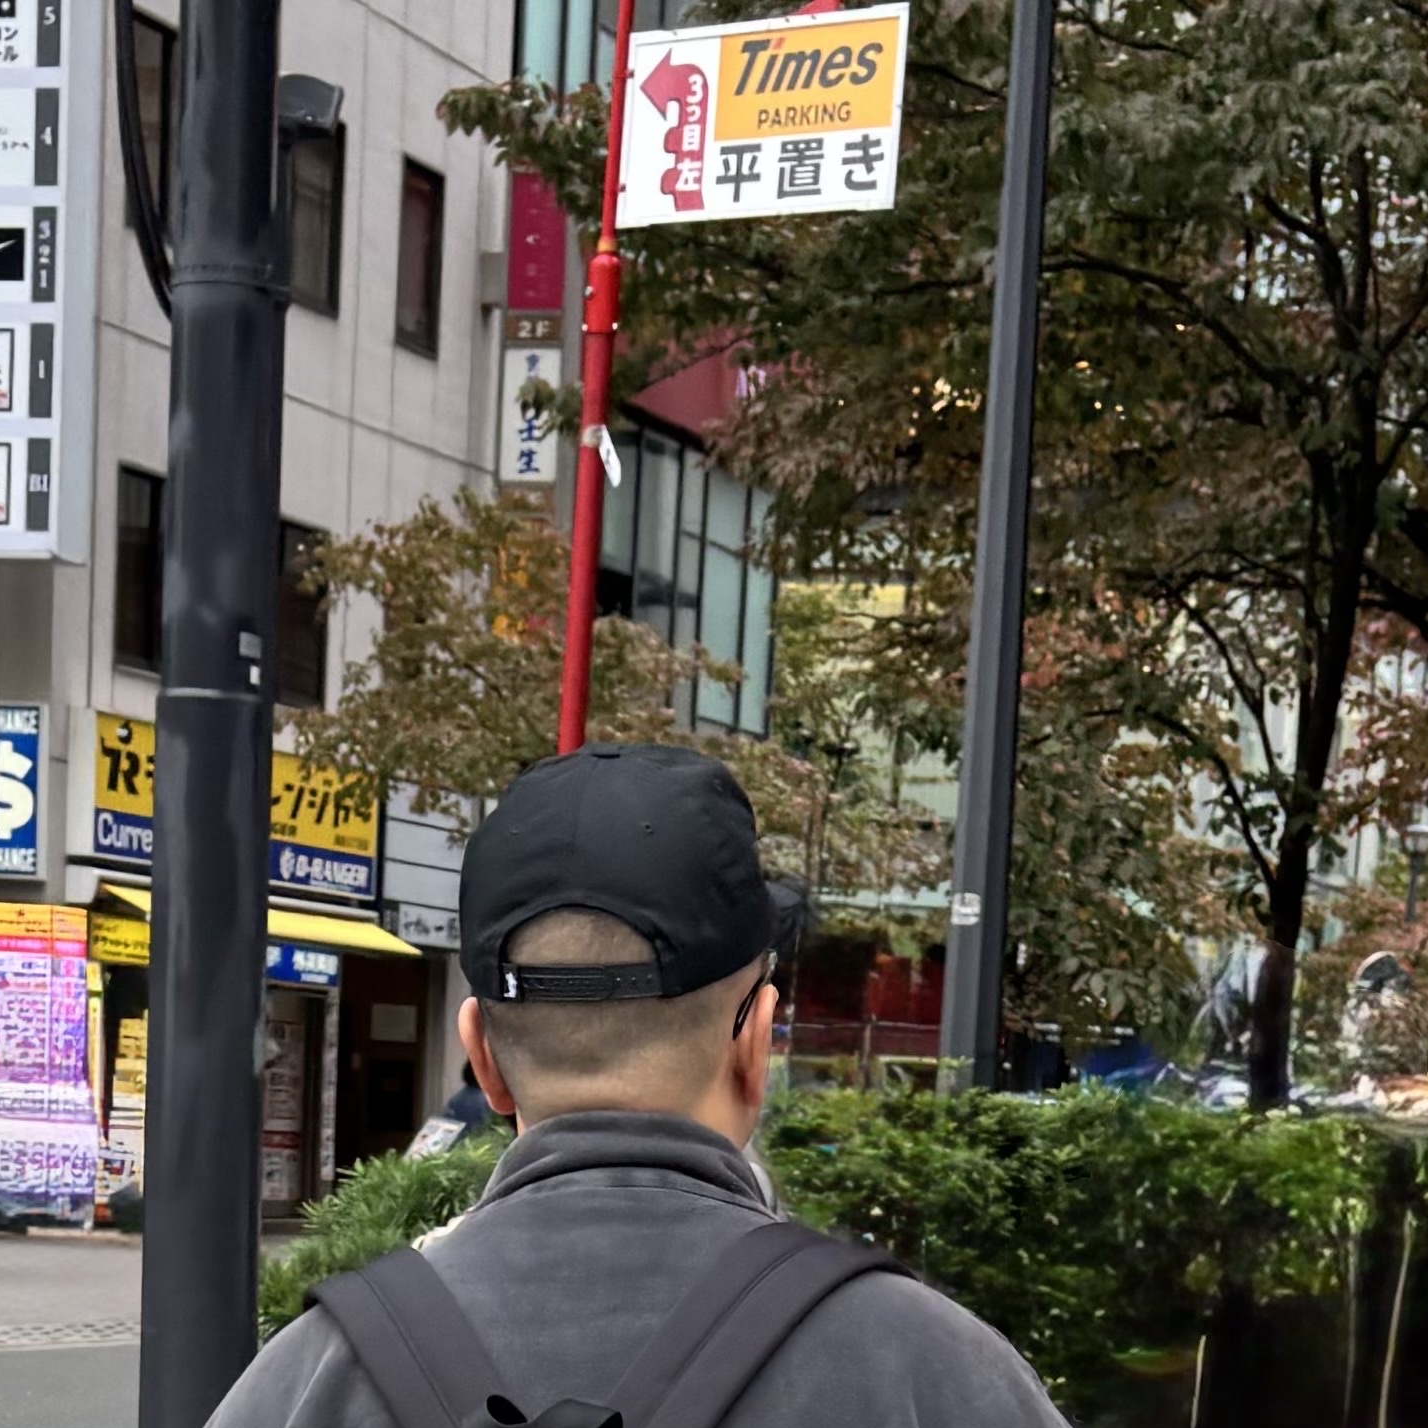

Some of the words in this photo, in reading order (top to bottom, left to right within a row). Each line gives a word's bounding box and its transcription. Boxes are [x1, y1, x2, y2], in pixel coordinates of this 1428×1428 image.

[43, 6, 56, 25] 5
[734, 37, 884, 96] Times
[675, 74, 704, 192] 3つ目左
[757, 101, 852, 130] PARKING
[716, 134, 885, 203] 平置き
[517, 320, 551, 338] 2F
[97, 812, 154, 852] Curre
